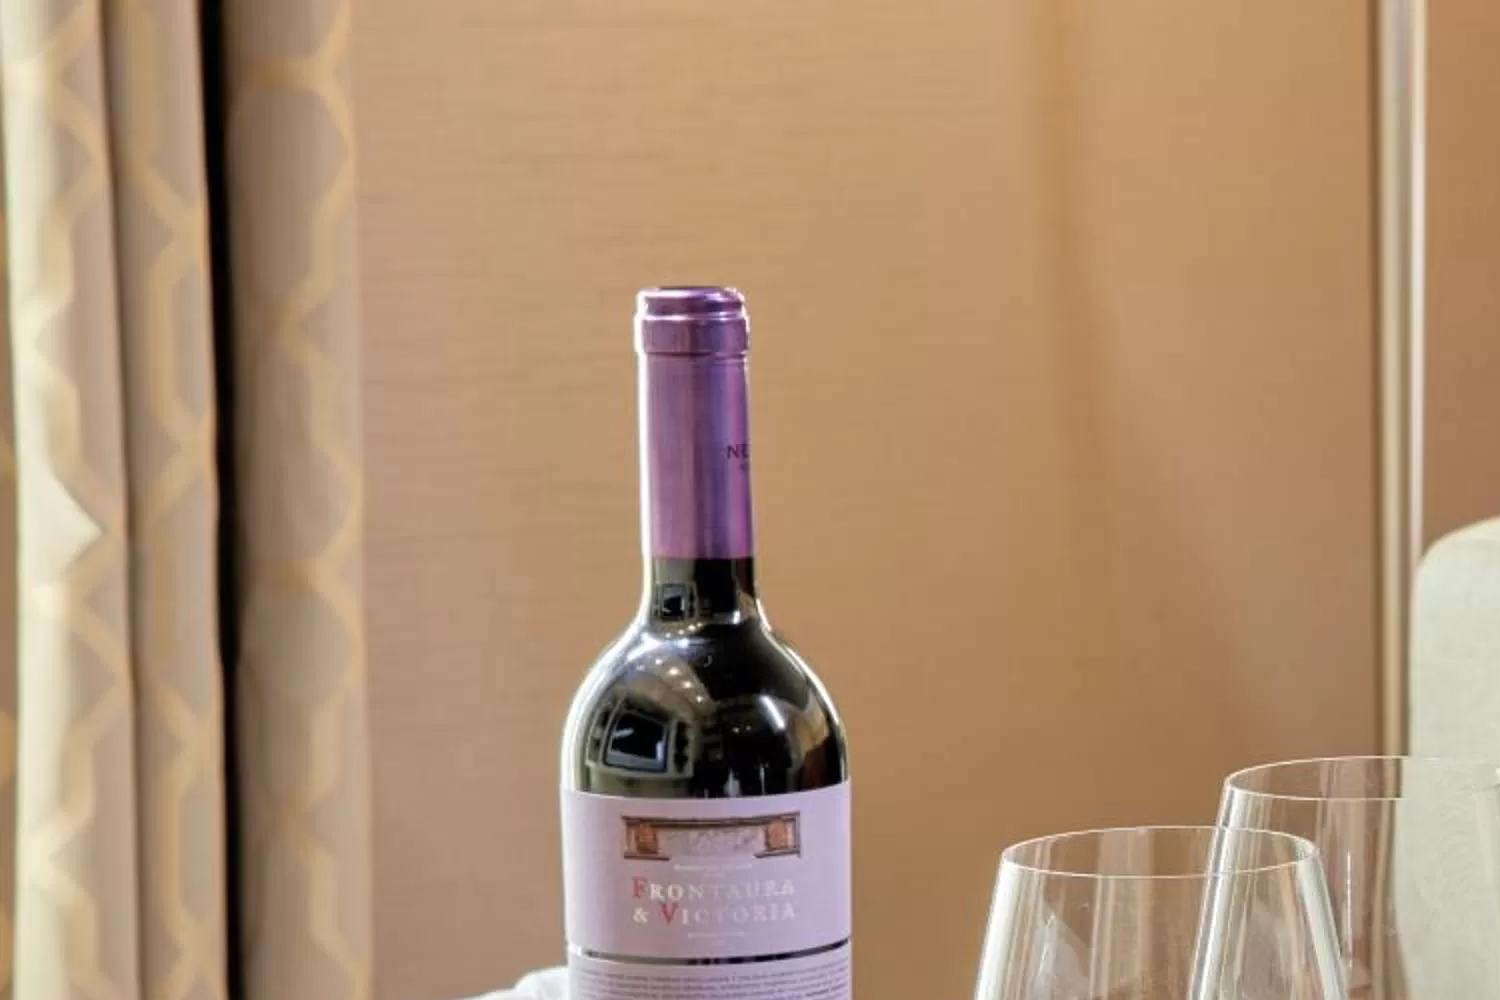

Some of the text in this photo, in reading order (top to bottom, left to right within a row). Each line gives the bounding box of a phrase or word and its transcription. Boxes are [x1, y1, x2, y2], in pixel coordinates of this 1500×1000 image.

[632, 875, 796, 901] FRONTAURA
[632, 902, 796, 925] & VICTORIA
